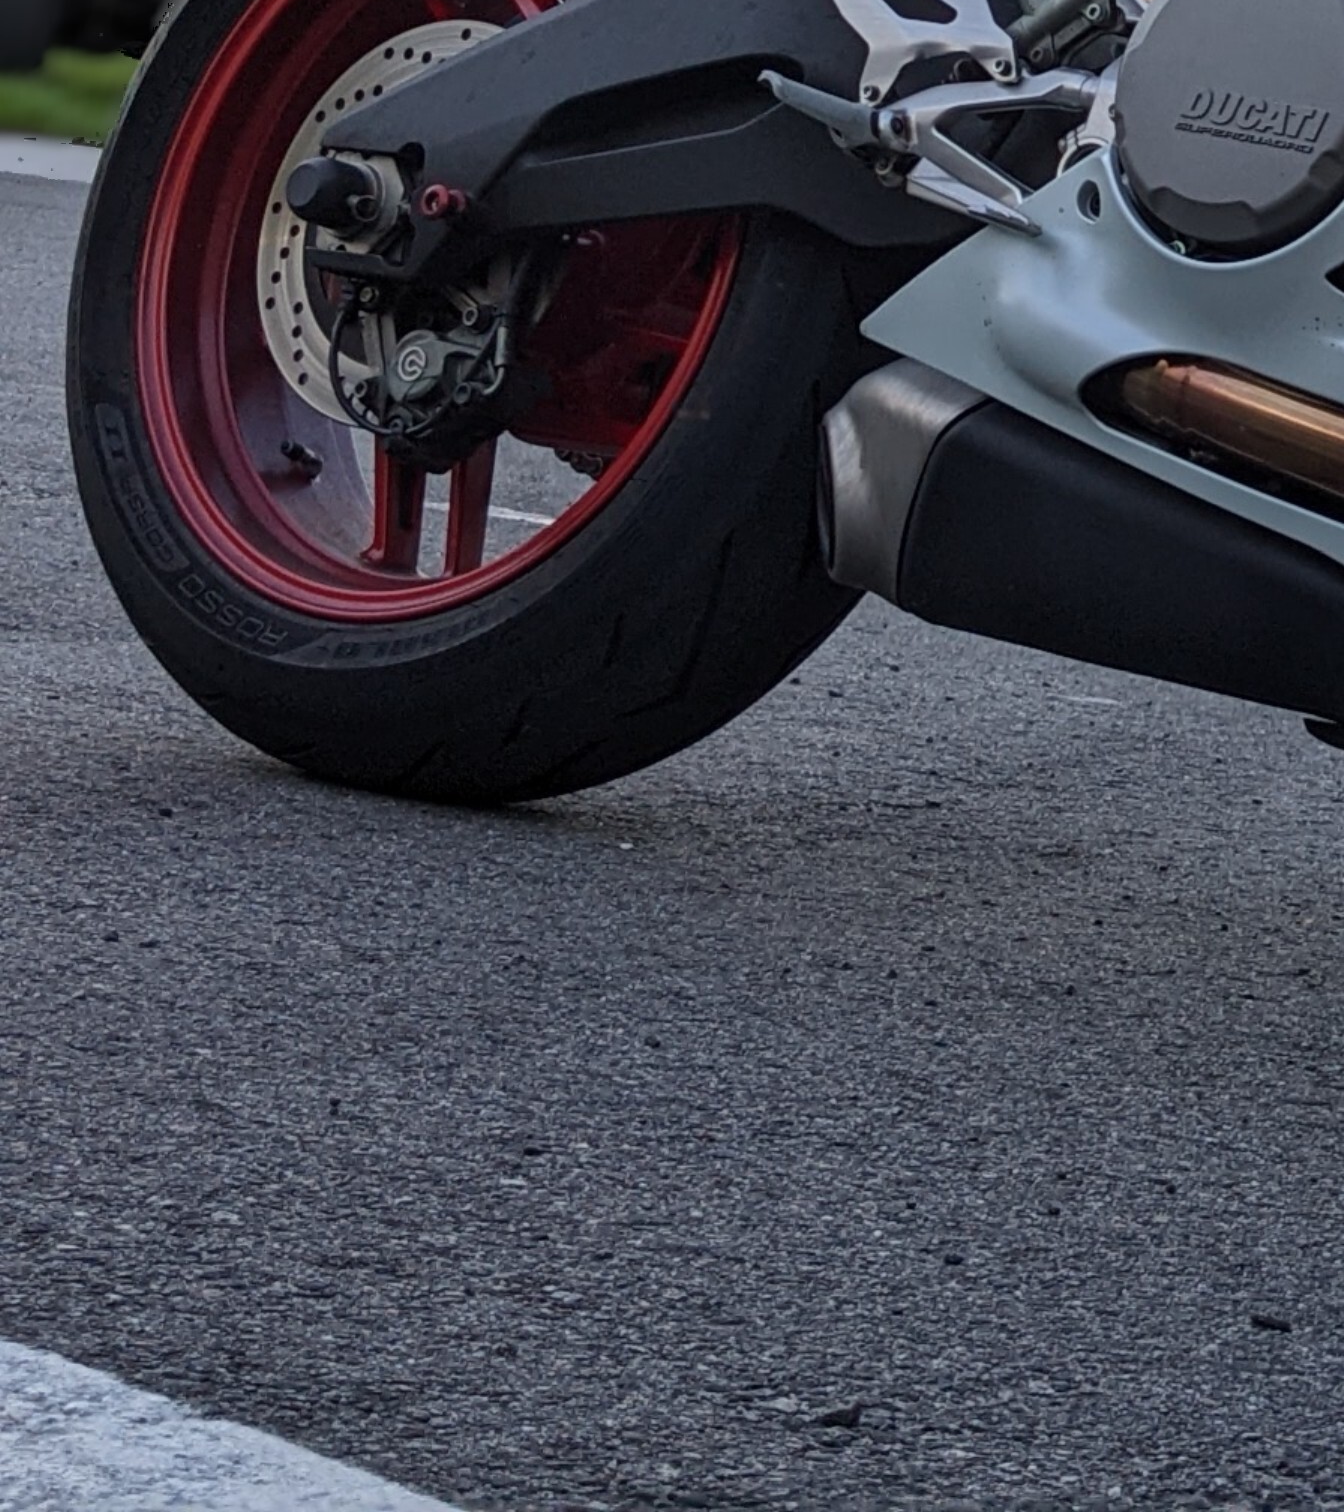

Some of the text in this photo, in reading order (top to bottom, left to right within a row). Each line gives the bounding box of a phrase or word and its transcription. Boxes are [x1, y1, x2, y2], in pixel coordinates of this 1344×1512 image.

[1173, 121, 1317, 156] SUPERQUADRO
[1178, 86, 1332, 145] DUCATI
[119, 476, 175, 564] CORSA
[177, 572, 289, 648] ROSSO
